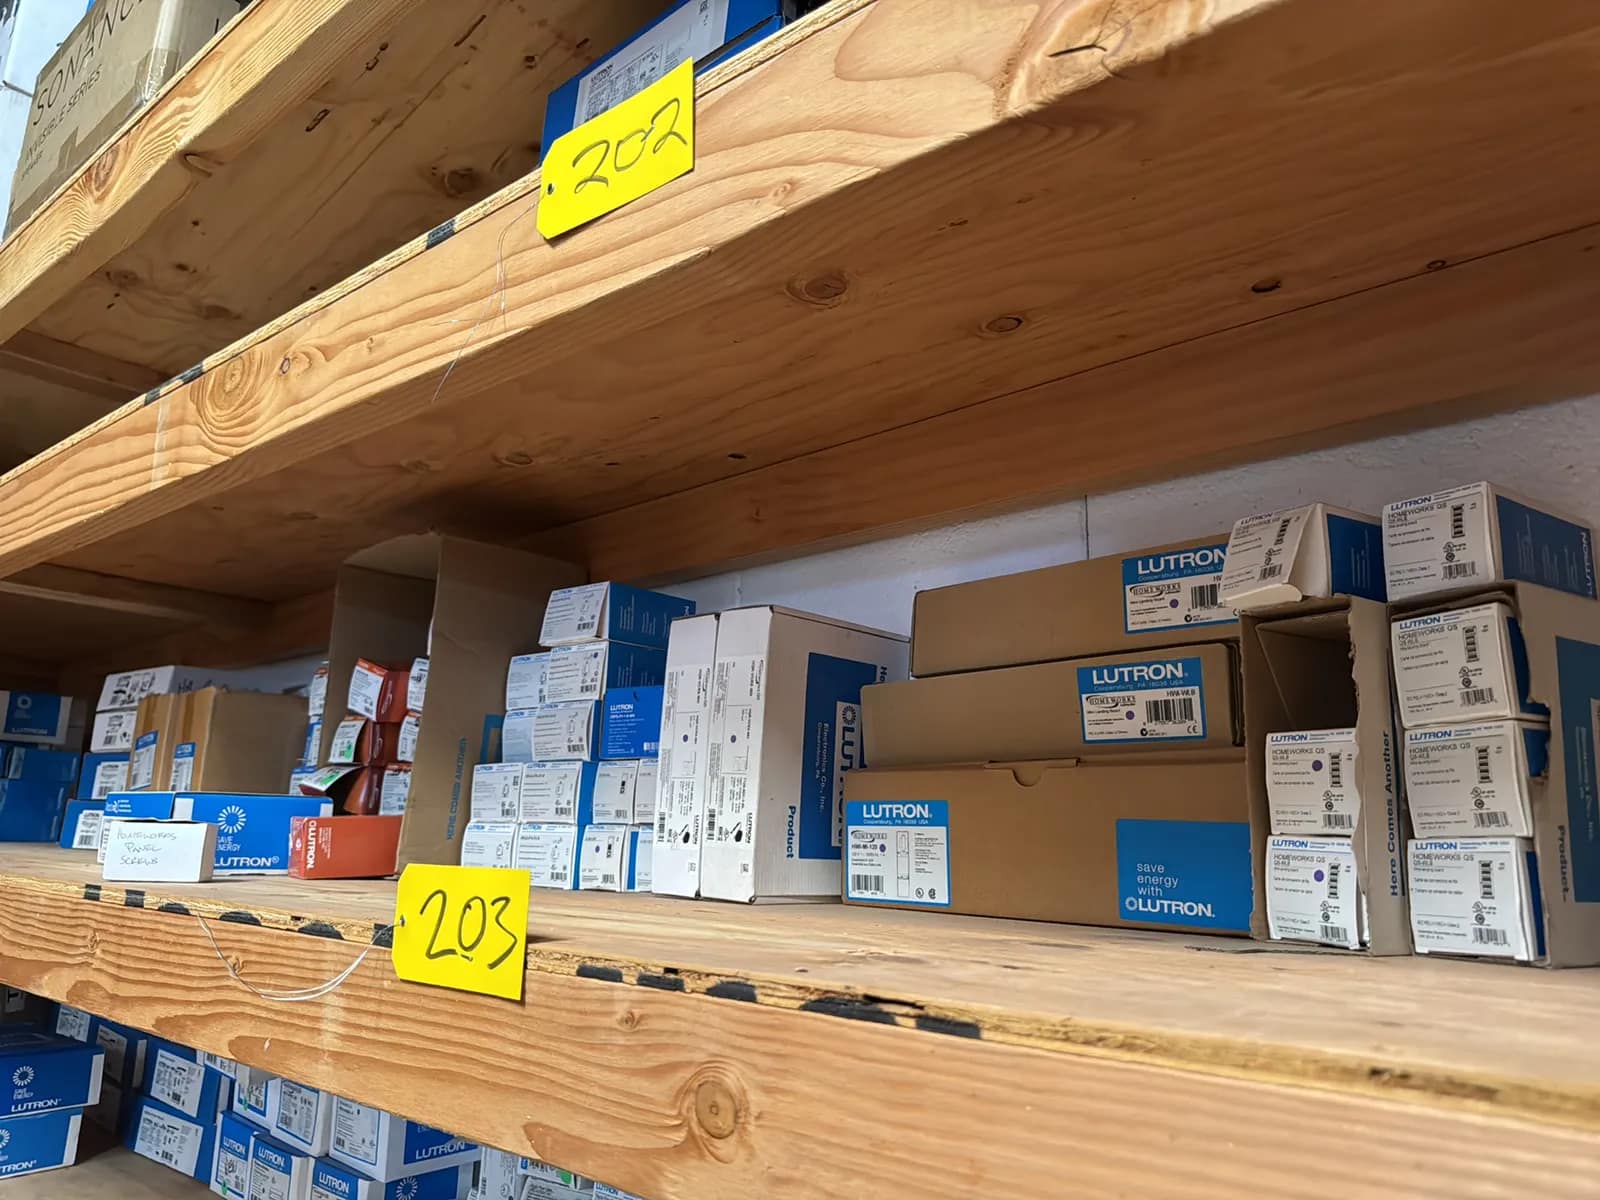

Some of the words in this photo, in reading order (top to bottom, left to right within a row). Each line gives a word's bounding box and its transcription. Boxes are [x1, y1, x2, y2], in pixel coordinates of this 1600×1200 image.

[572, 98, 688, 195] 202
[1390, 496, 1432, 511] LUTRON
[1137, 548, 1229, 575] LUTRON
[1399, 616, 1441, 630] LUTRON
[1398, 625, 1445, 641] HOMEWORKS
[1447, 624, 1458, 632] QS
[1092, 662, 1184, 685] LUTRON
[1271, 734, 1308, 743] LUTRON
[1409, 730, 1452, 741] LUTRON
[1272, 747, 1314, 756] HOMEWORKS
[1410, 743, 1457, 755] HOMEWORKS
[1460, 742, 1471, 750] QS
[1383, 731, 1393, 794] Another
[863, 804, 929, 819] LUTRON
[745, 812, 753, 844] LUTRON
[786, 805, 797, 859] Product
[1386, 799, 1396, 853] Comes
[124, 842, 162, 854] PANEL
[216, 843, 241, 852] NERGY
[306, 827, 317, 870] LUTRON
[1272, 840, 1309, 849] LUTRON
[1415, 841, 1458, 850] LUTRON
[1273, 853, 1315, 863] HOMEWORKS
[1316, 856, 1326, 864] QS
[1413, 852, 1461, 861] HOMEWORKS
[1136, 863, 1165, 873] save
[1137, 875, 1178, 888] energy
[1390, 858, 1399, 896] Here
[1137, 885, 1163, 897] with
[420, 889, 518, 970] 203
[223, 1136, 246, 1156] LUTRON
[415, 1141, 466, 1160] LUTRON
[258, 1146, 285, 1167] LUTRON
[319, 1171, 350, 1194] LUTRON
